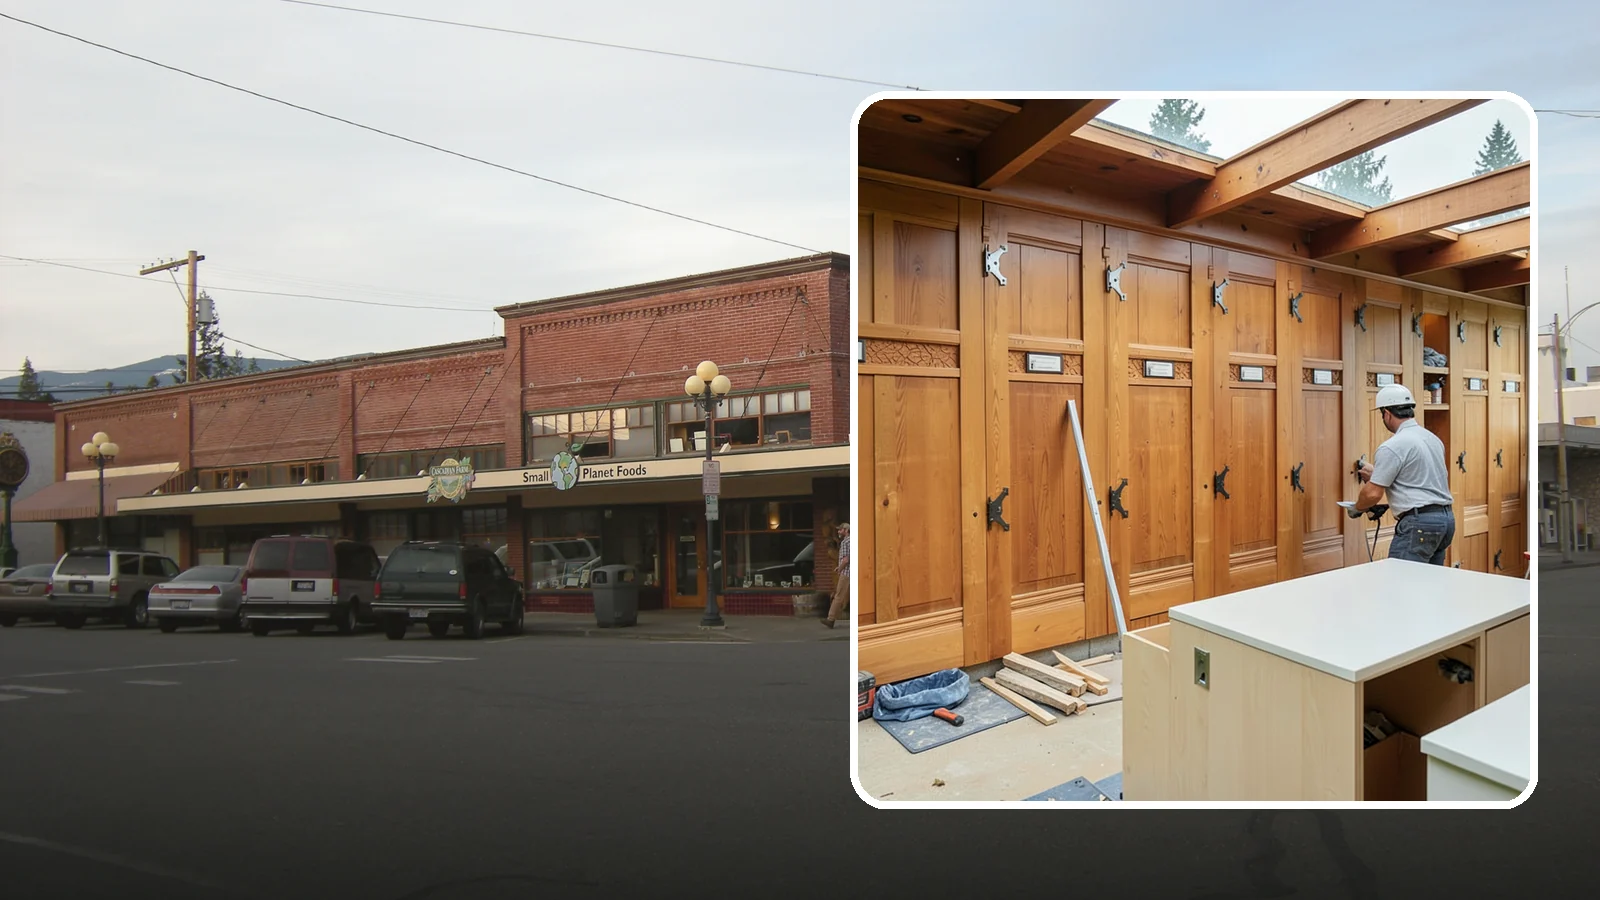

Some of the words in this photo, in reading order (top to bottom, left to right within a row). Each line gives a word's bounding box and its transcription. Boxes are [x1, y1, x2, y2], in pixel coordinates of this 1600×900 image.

[523, 471, 549, 483] Small
[582, 468, 614, 479] Planet
[617, 464, 647, 477] Foods
